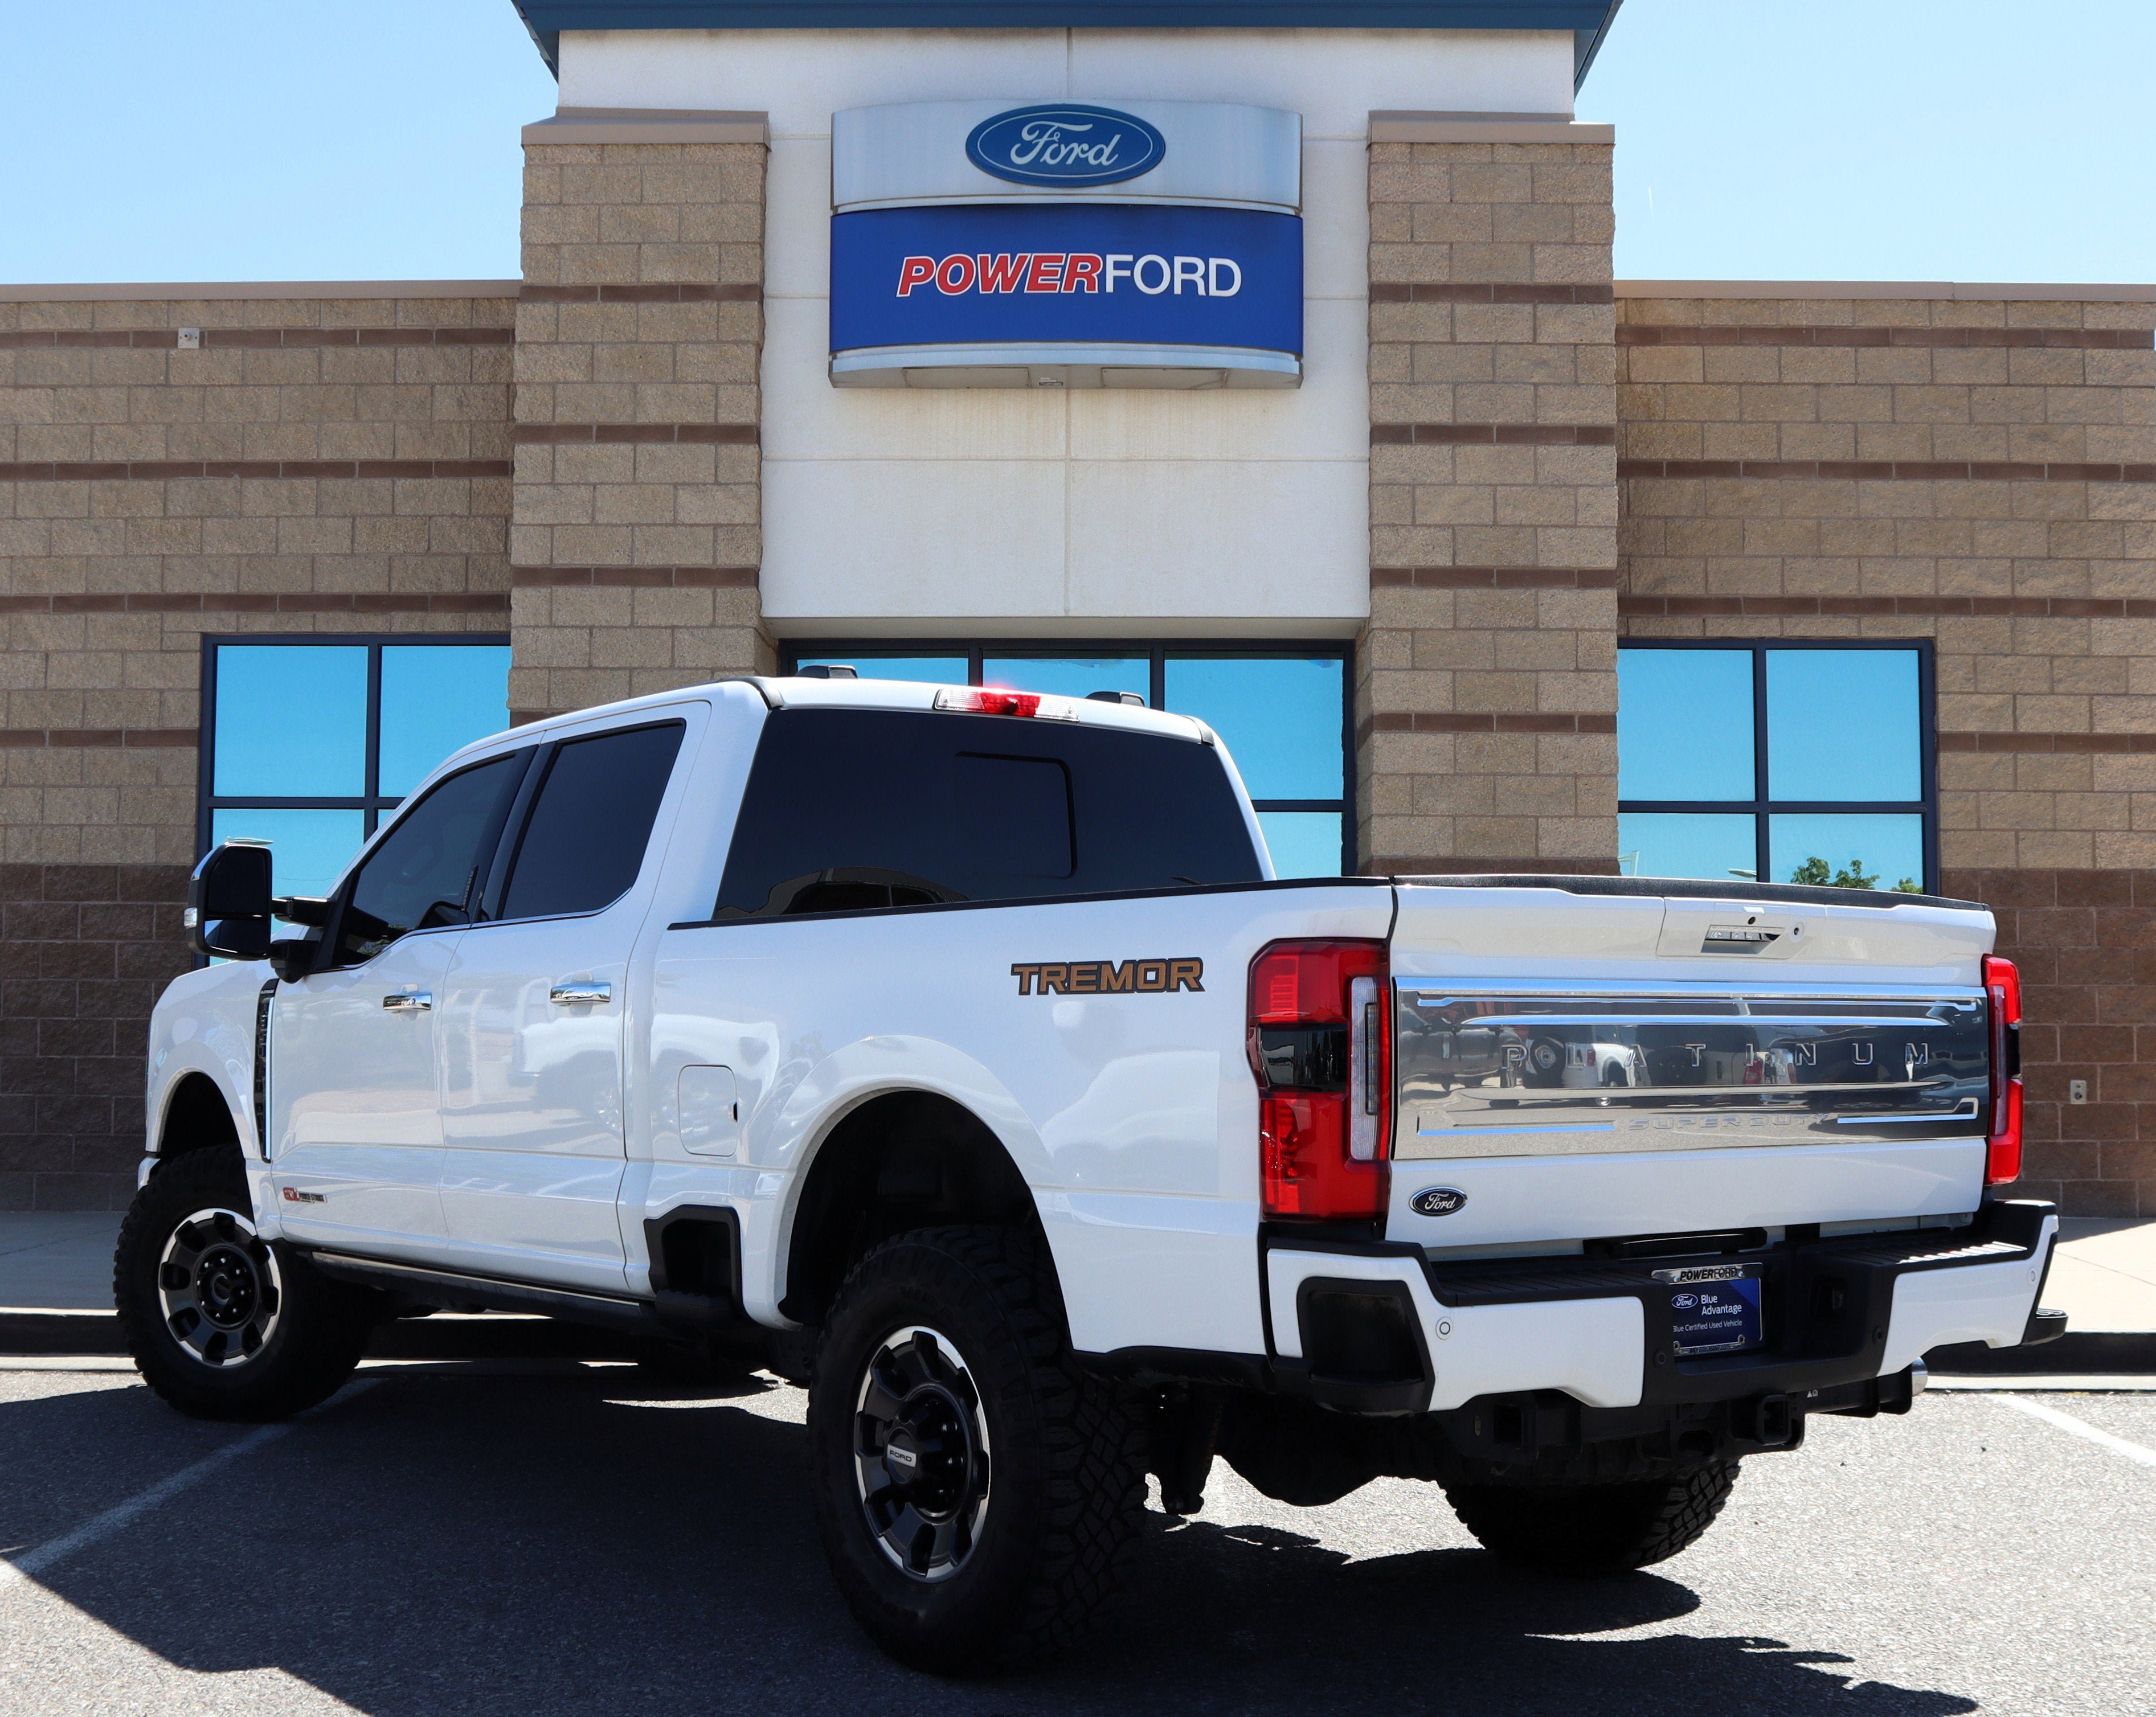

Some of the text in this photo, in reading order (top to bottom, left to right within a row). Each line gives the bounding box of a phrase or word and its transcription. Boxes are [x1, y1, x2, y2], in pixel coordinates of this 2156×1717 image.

[1009, 121, 1122, 166] Ford
[896, 252, 1243, 298] POWERFORD
[1011, 957, 1205, 995] TREMOR
[1500, 1042, 1929, 1070] PLATINUM
[1628, 1113, 1829, 1130] SUPER DUTY
[1425, 1193, 1457, 1210] Ford
[1680, 1268, 1737, 1281] POWERFORD
[1676, 1296, 1693, 1306] Ford
[1701, 1294, 1718, 1304] Blue
[1701, 1304, 1742, 1316] Advantage
[1684, 1322, 1708, 1331] Certified
[1708, 1321, 1723, 1329] Used
[889, 1450, 913, 1462] FORD
